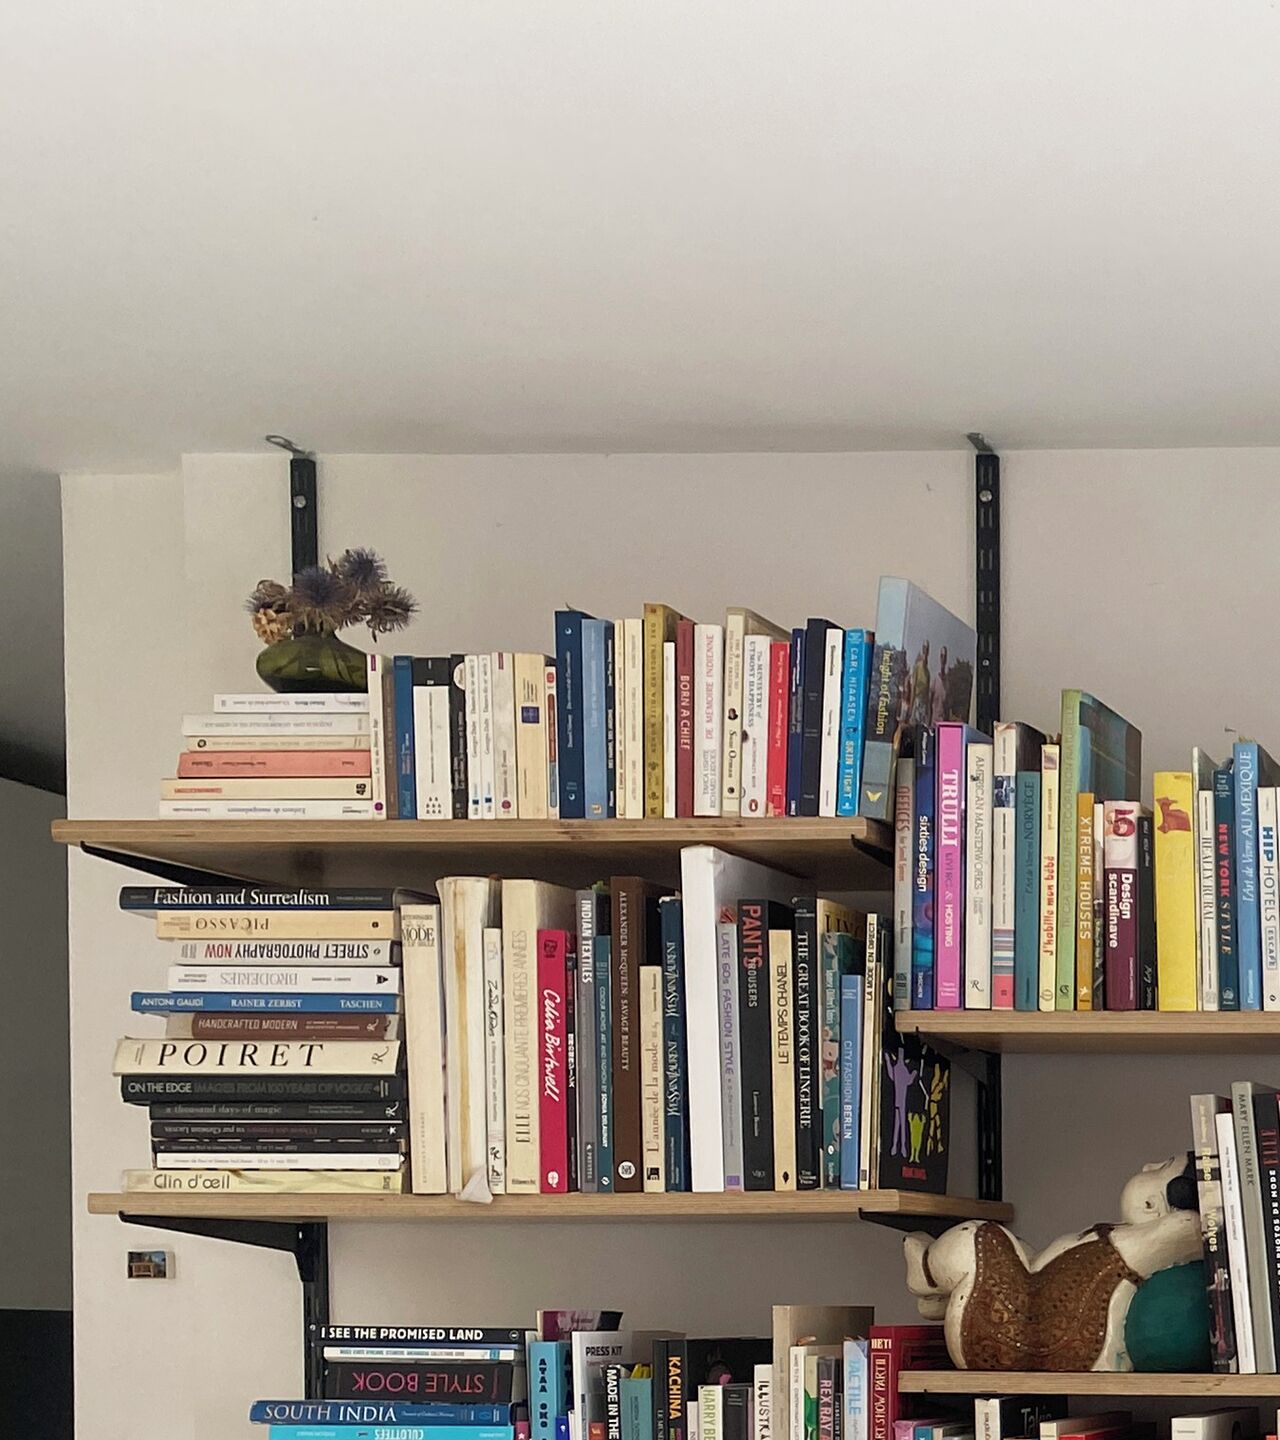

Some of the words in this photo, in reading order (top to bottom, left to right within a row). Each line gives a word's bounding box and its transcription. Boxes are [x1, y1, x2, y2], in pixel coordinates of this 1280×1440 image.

[680, 676, 690, 706] BORN
[680, 708, 690, 717] A
[682, 718, 690, 751] CHIEF
[845, 740, 854, 766] SKIN
[844, 768, 852, 799] TIGHT
[919, 815, 928, 852] sixties
[1080, 816, 1091, 876] XTREME
[1262, 826, 1274, 862] HIP
[918, 852, 930, 892] design
[154, 888, 212, 906] Fashion
[216, 890, 244, 904] and
[250, 889, 329, 906] Surrealism
[1121, 873, 1132, 919] Design
[1264, 865, 1276, 922] HOTELS
[196, 918, 268, 930] PICASSO
[582, 900, 592, 936] INDIAN
[1080, 879, 1092, 940] HOUSES
[1108, 872, 1118, 948] scandinave
[205, 945, 232, 958] NOW
[235, 945, 320, 958] PHOTOGRAPHY
[324, 944, 368, 958] STREET
[742, 905, 762, 968] PANTS
[582, 940, 592, 984] TEXTILES
[778, 962, 788, 1007] CHANEL
[231, 999, 264, 1008] RAINER
[268, 999, 302, 1008] ZERBST
[340, 999, 382, 1008] TASCHEN
[544, 989, 560, 1032] Celia
[198, 1018, 259, 1030] HANDCRAFTED
[262, 1020, 298, 1030] MODERN
[779, 1010, 788, 1048] TEMPS
[158, 1044, 322, 1067] POIRET
[544, 1034, 560, 1100] Birtwell
[779, 1050, 788, 1064] LE
[128, 1082, 144, 1092] ON
[146, 1082, 164, 1092] THE
[166, 1082, 192, 1092] EDGE
[154, 1174, 182, 1190] Clin
[321, 1328, 325, 1338] I
[329, 1328, 350, 1338] SEE
[354, 1328, 376, 1338] THE
[380, 1329, 446, 1340] PROMISED
[450, 1330, 483, 1340] LAND
[352, 1373, 418, 1391] BOOK
[426, 1374, 484, 1391] STYLE
[668, 1356, 681, 1419] KACHINA
[265, 1404, 330, 1419] SOUTH
[339, 1404, 396, 1421] INDIA
